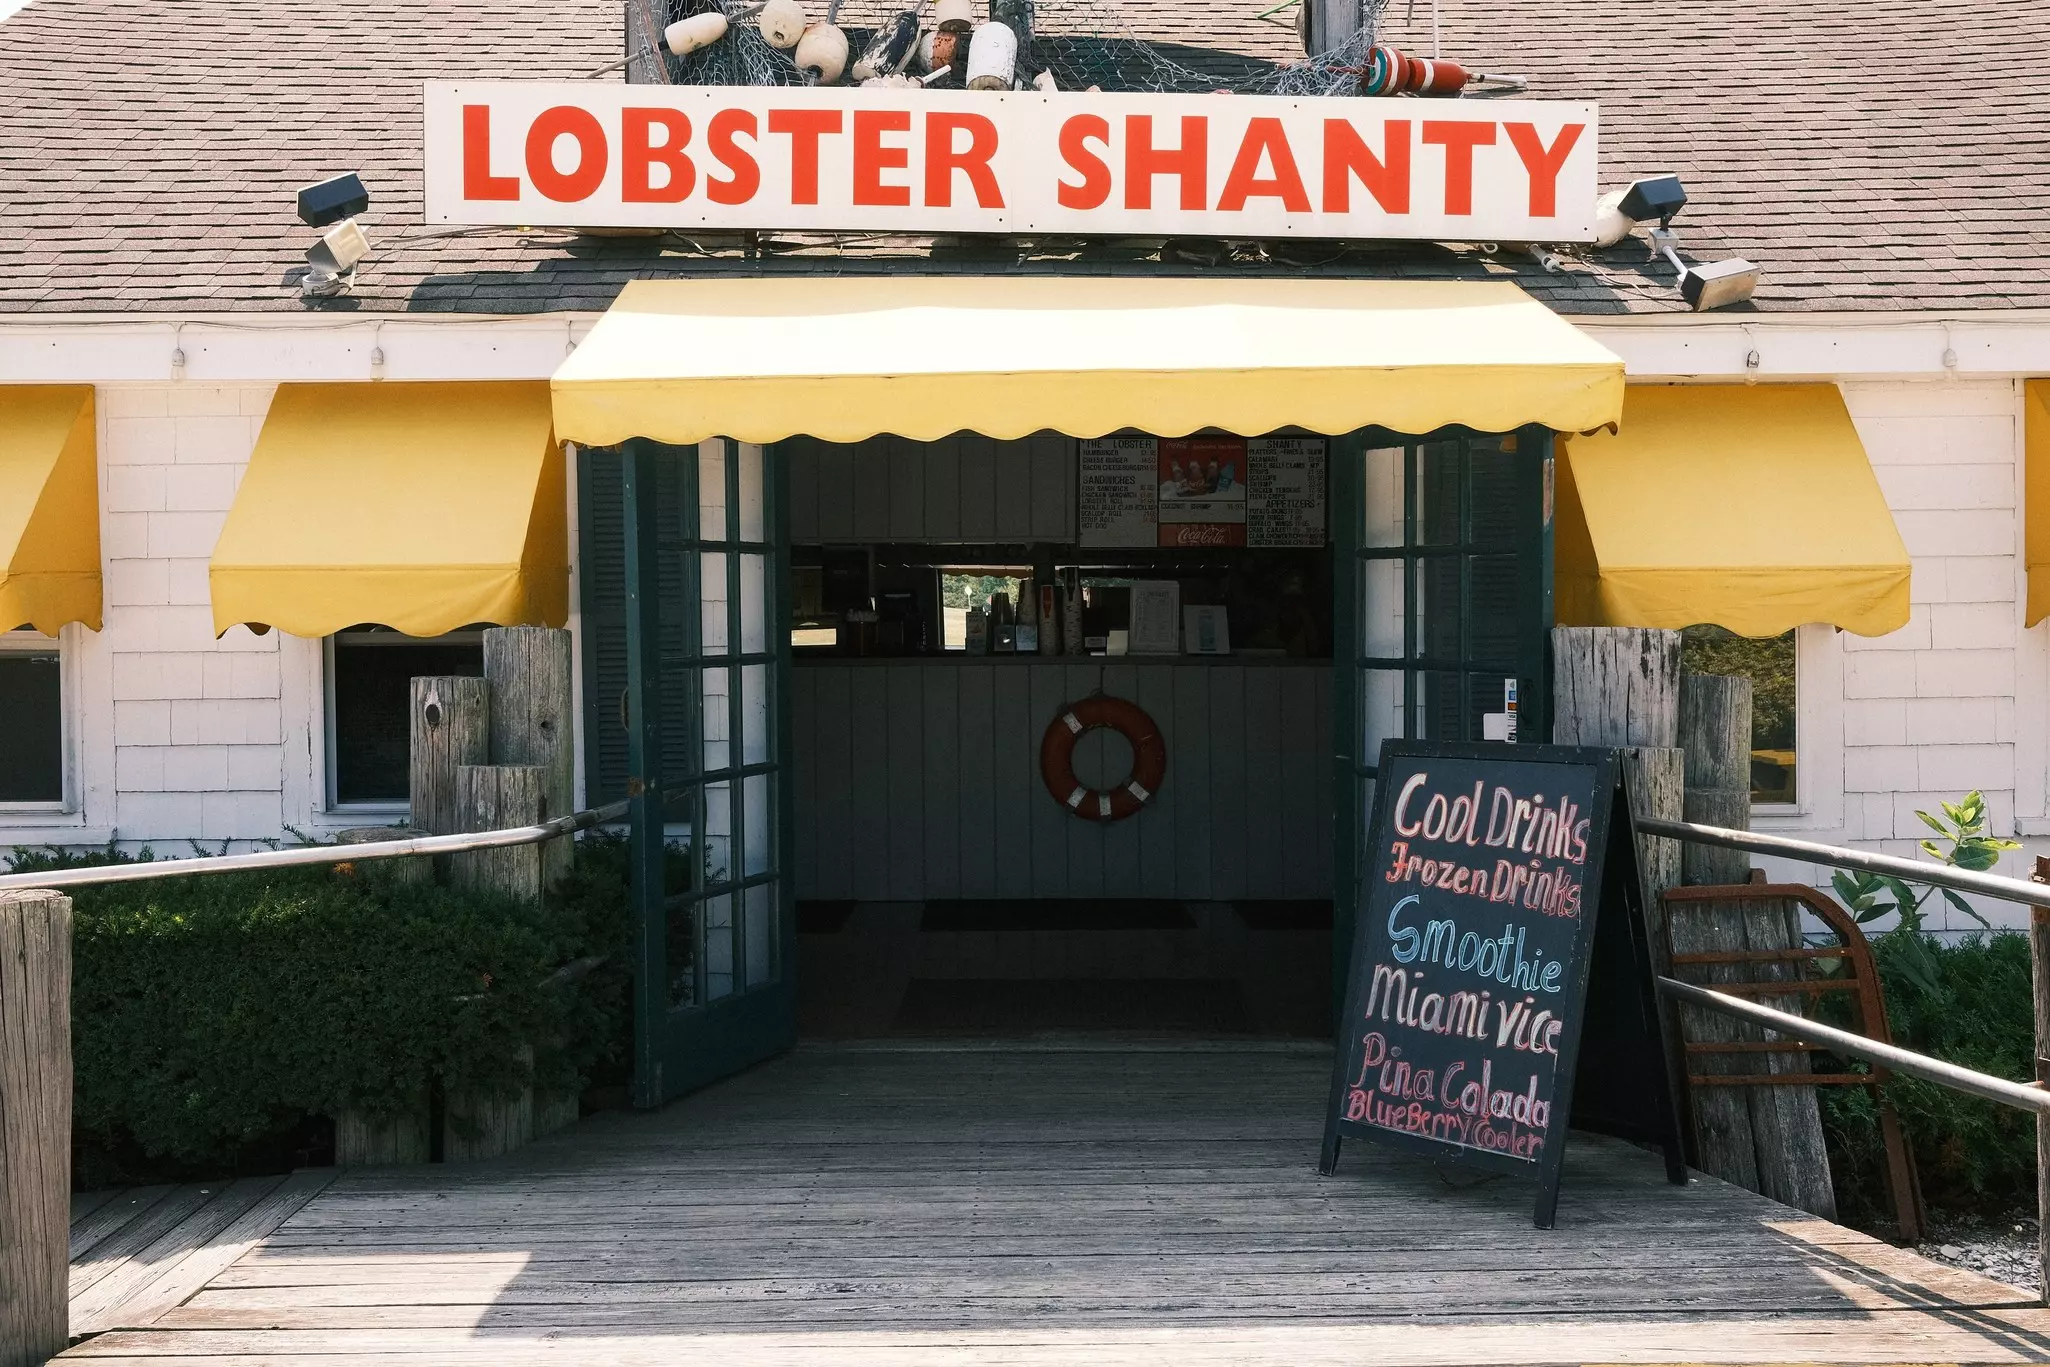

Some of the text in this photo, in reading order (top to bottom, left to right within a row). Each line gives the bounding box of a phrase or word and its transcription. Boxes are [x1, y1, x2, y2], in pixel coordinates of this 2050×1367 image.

[463, 104, 1586, 217] LOBSTER SHANTY
[1087, 440, 1152, 449] THE LOBSTER
[1267, 440, 1302, 449] SHANTY
[1083, 475, 1136, 485] SANDWICHES
[1266, 499, 1315, 508] APPETIZERS
[1177, 527, 1226, 544] Coca-Cola
[1394, 773, 1590, 864] Cool Drinks
[1386, 841, 1581, 918] Frozen Drinks
[1387, 894, 1562, 992] Smoothie
[1365, 964, 1490, 1040] Miami
[1350, 1032, 1551, 1129] Pina Colada
[1471, 1118, 1546, 1157] Cooler
